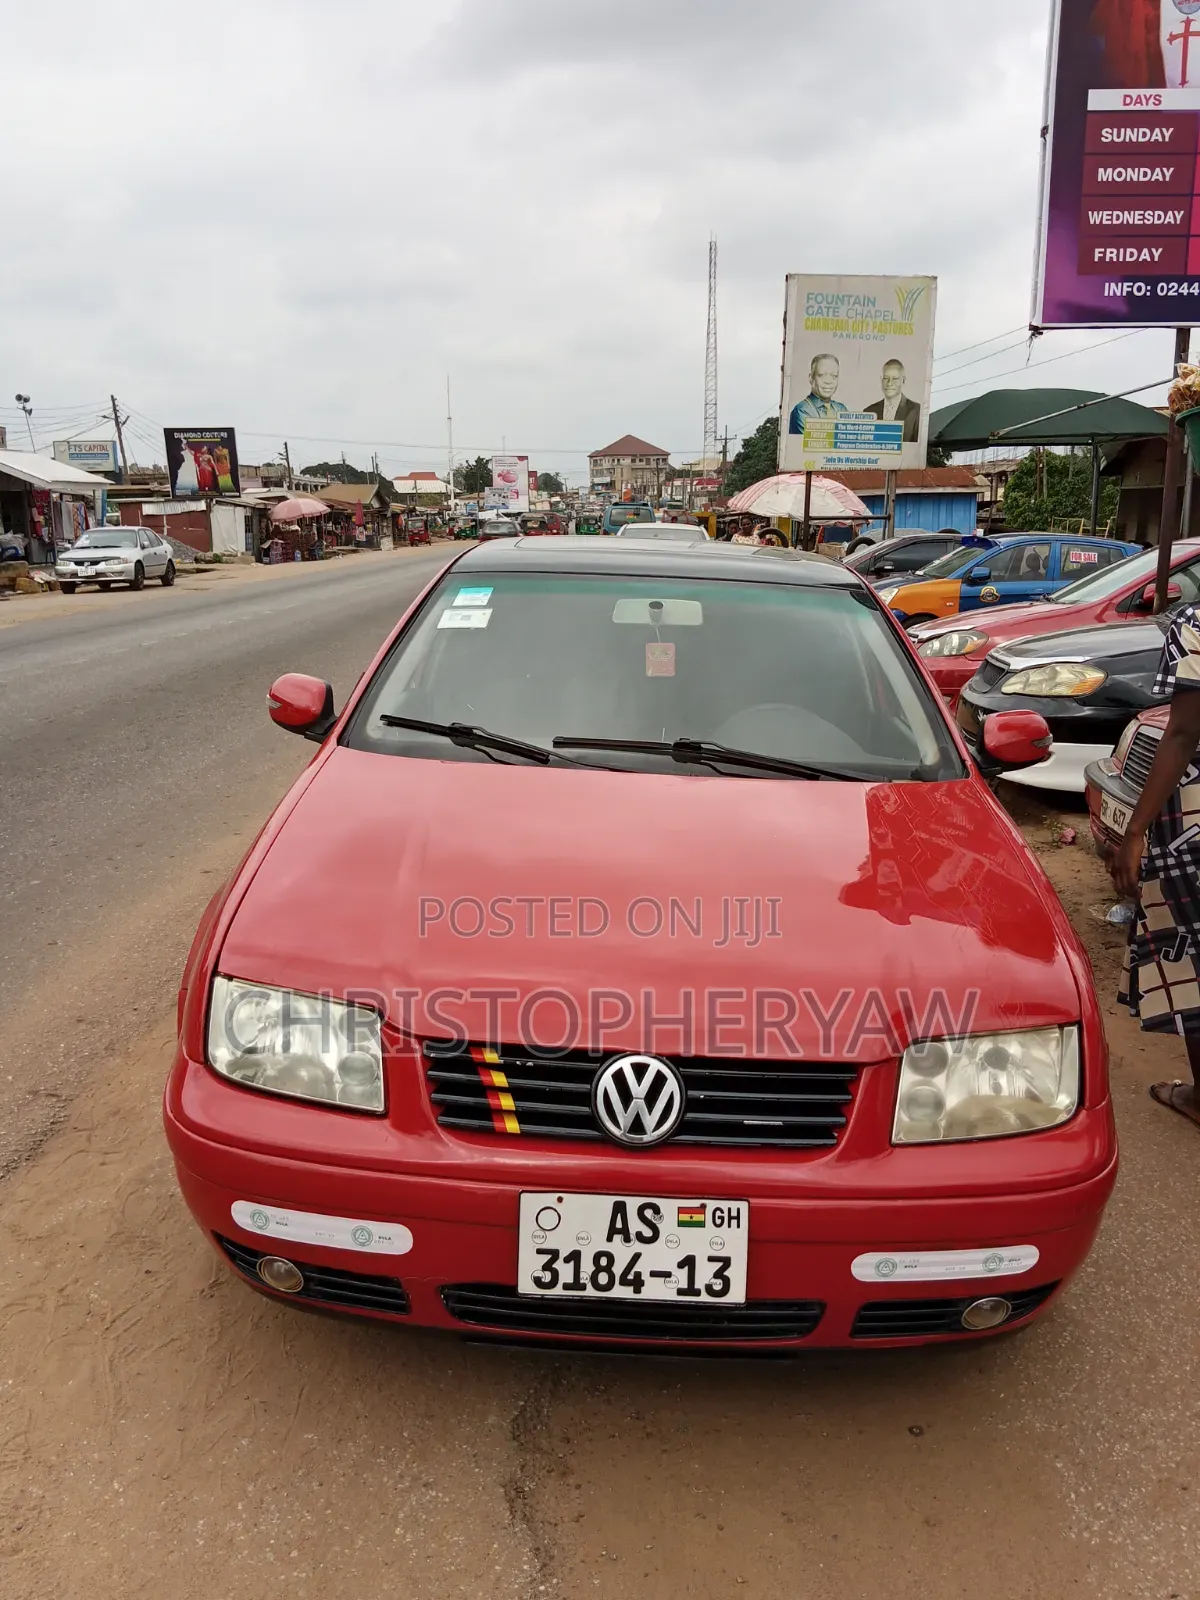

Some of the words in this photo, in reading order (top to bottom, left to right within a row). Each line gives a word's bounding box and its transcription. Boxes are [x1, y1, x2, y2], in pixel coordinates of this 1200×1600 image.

[1121, 94, 1163, 107] DAYS
[1100, 128, 1174, 142] SUNDAY
[1097, 168, 1174, 182] MONDAY
[1088, 210, 1184, 225] WEDNESDAY
[1093, 248, 1163, 262] FRIDAY
[1103, 282, 1152, 297] INFO:
[1156, 281, 1200, 296] 0244
[806, 293, 876, 307] FOUNTAIN
[805, 306, 840, 317] GATE
[847, 309, 896, 321] CHAPEL
[852, 320, 869, 332] CITY
[873, 322, 914, 335] PASTURES
[173, 431, 202, 439] DIAMOND
[84, 444, 110, 452] CAPITAL
[1071, 552, 1082, 560] FOR
[1082, 552, 1097, 562] SALE
[1112, 806, 1127, 829] 637
[606, 1200, 661, 1244] AS
[712, 1206, 741, 1229] GH
[533, 1247, 732, 1298] 3184-13
